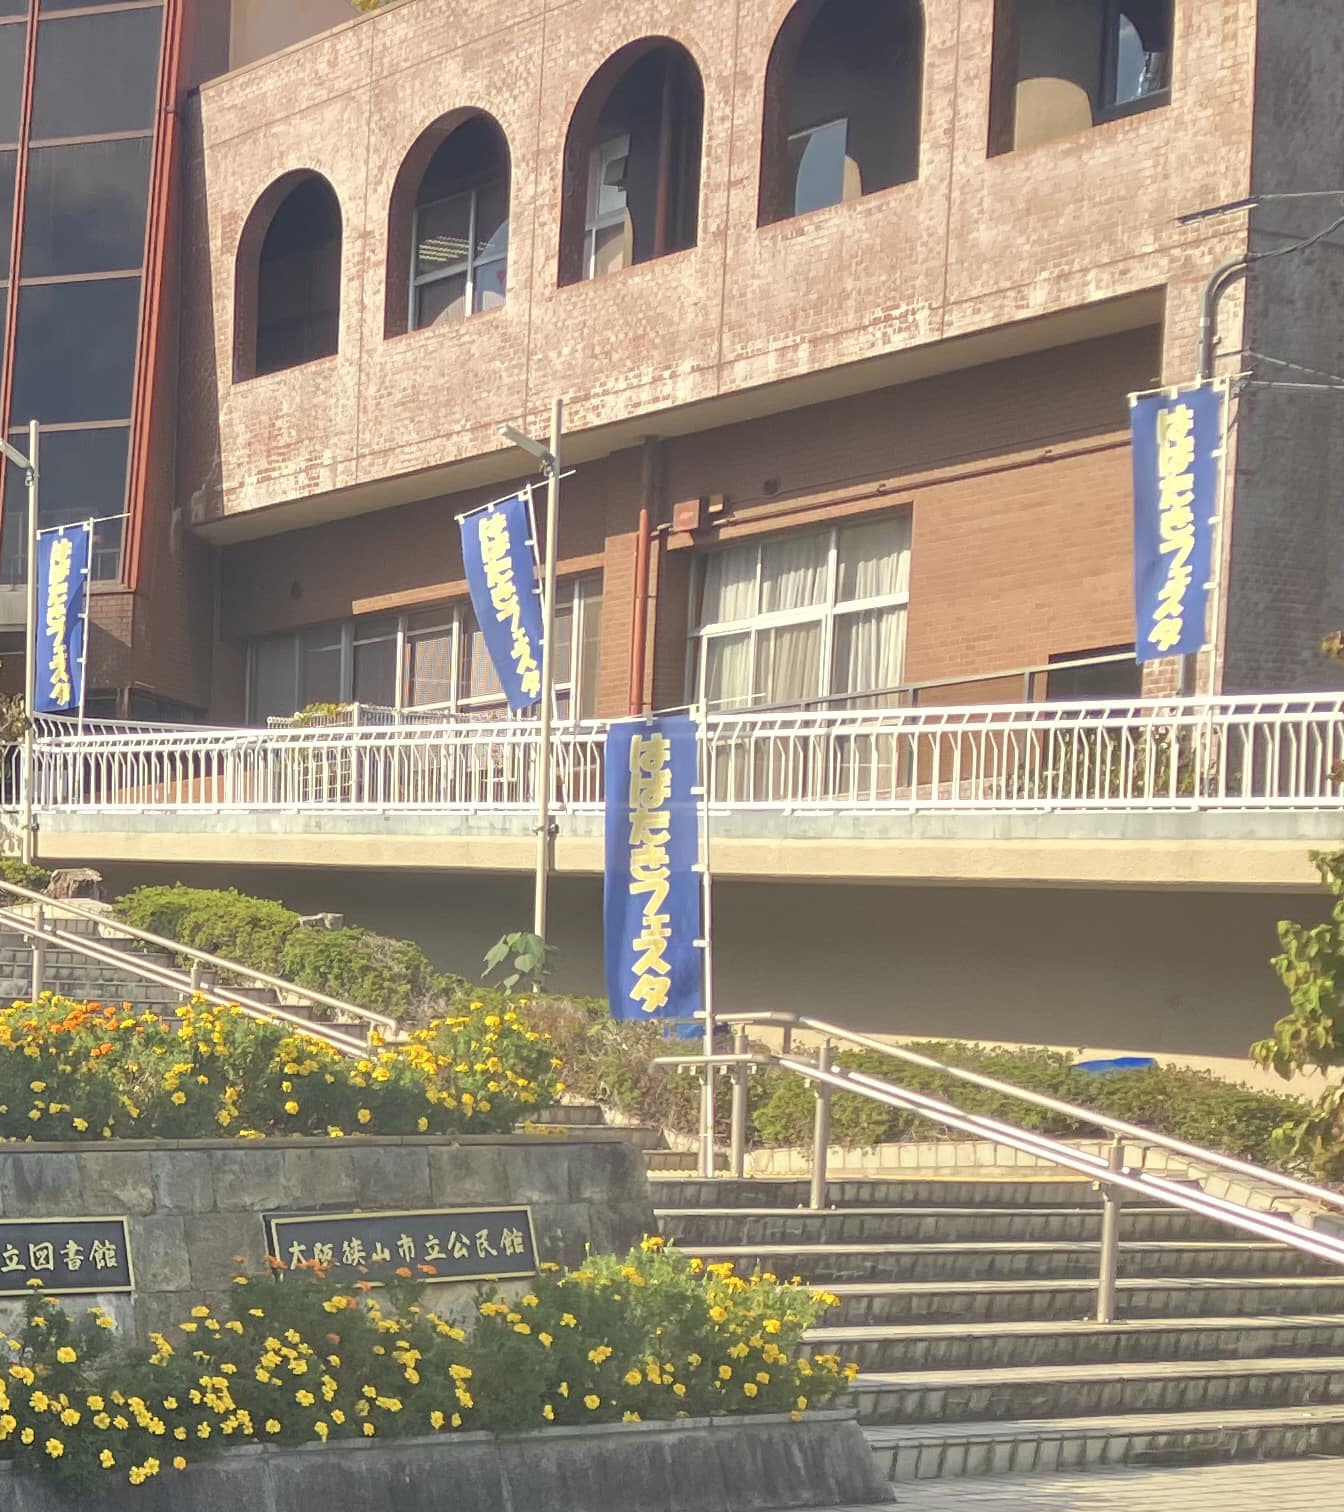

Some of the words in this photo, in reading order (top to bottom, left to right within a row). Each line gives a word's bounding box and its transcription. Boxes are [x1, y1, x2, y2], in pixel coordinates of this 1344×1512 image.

[629, 732, 672, 1013] はばたきフェスタ
[288, 1227, 525, 1270] 大阪狭山市立公民館
